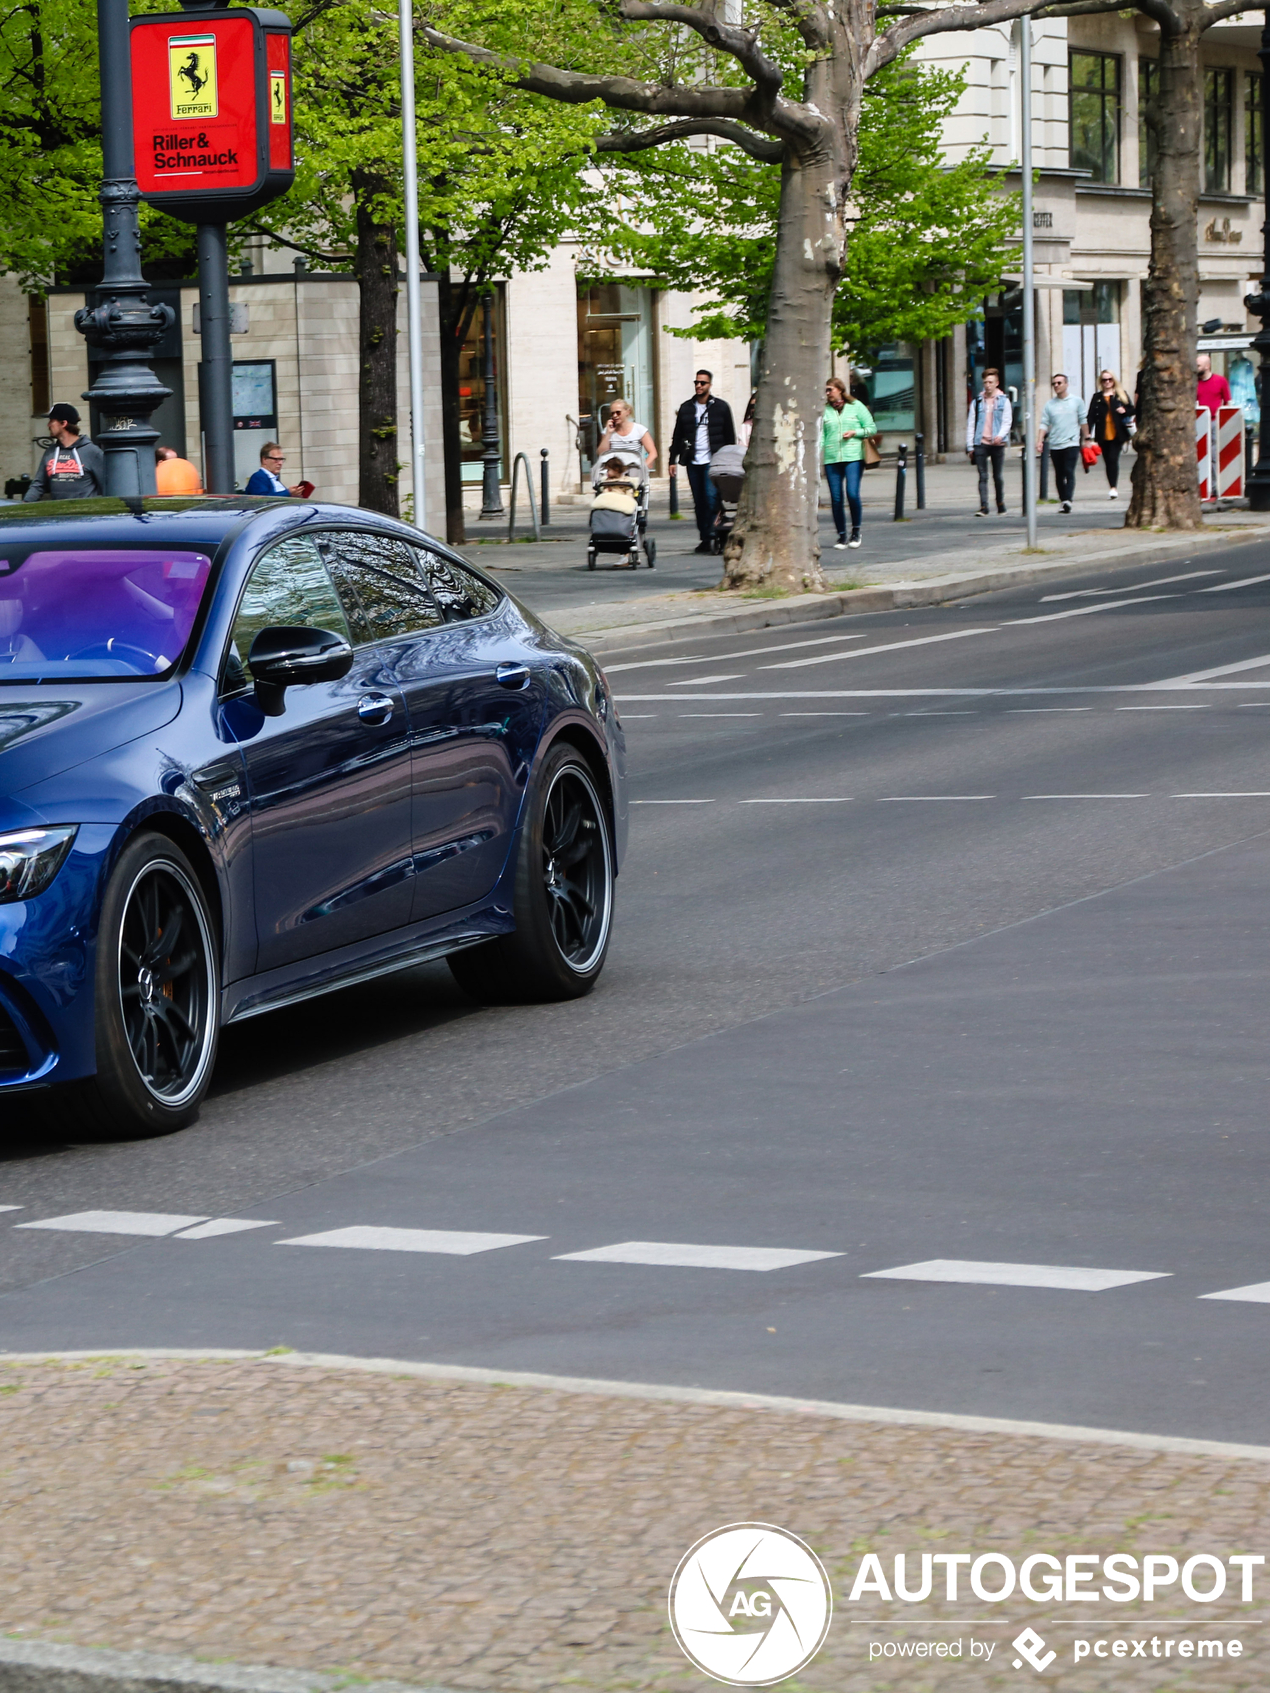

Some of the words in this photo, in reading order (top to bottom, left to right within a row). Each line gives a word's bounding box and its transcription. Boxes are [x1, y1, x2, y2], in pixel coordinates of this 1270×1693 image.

[176, 103, 212, 114] Ferrari
[153, 134, 195, 151] Riller
[197, 132, 209, 149] &
[154, 149, 238, 169] Schnauck
